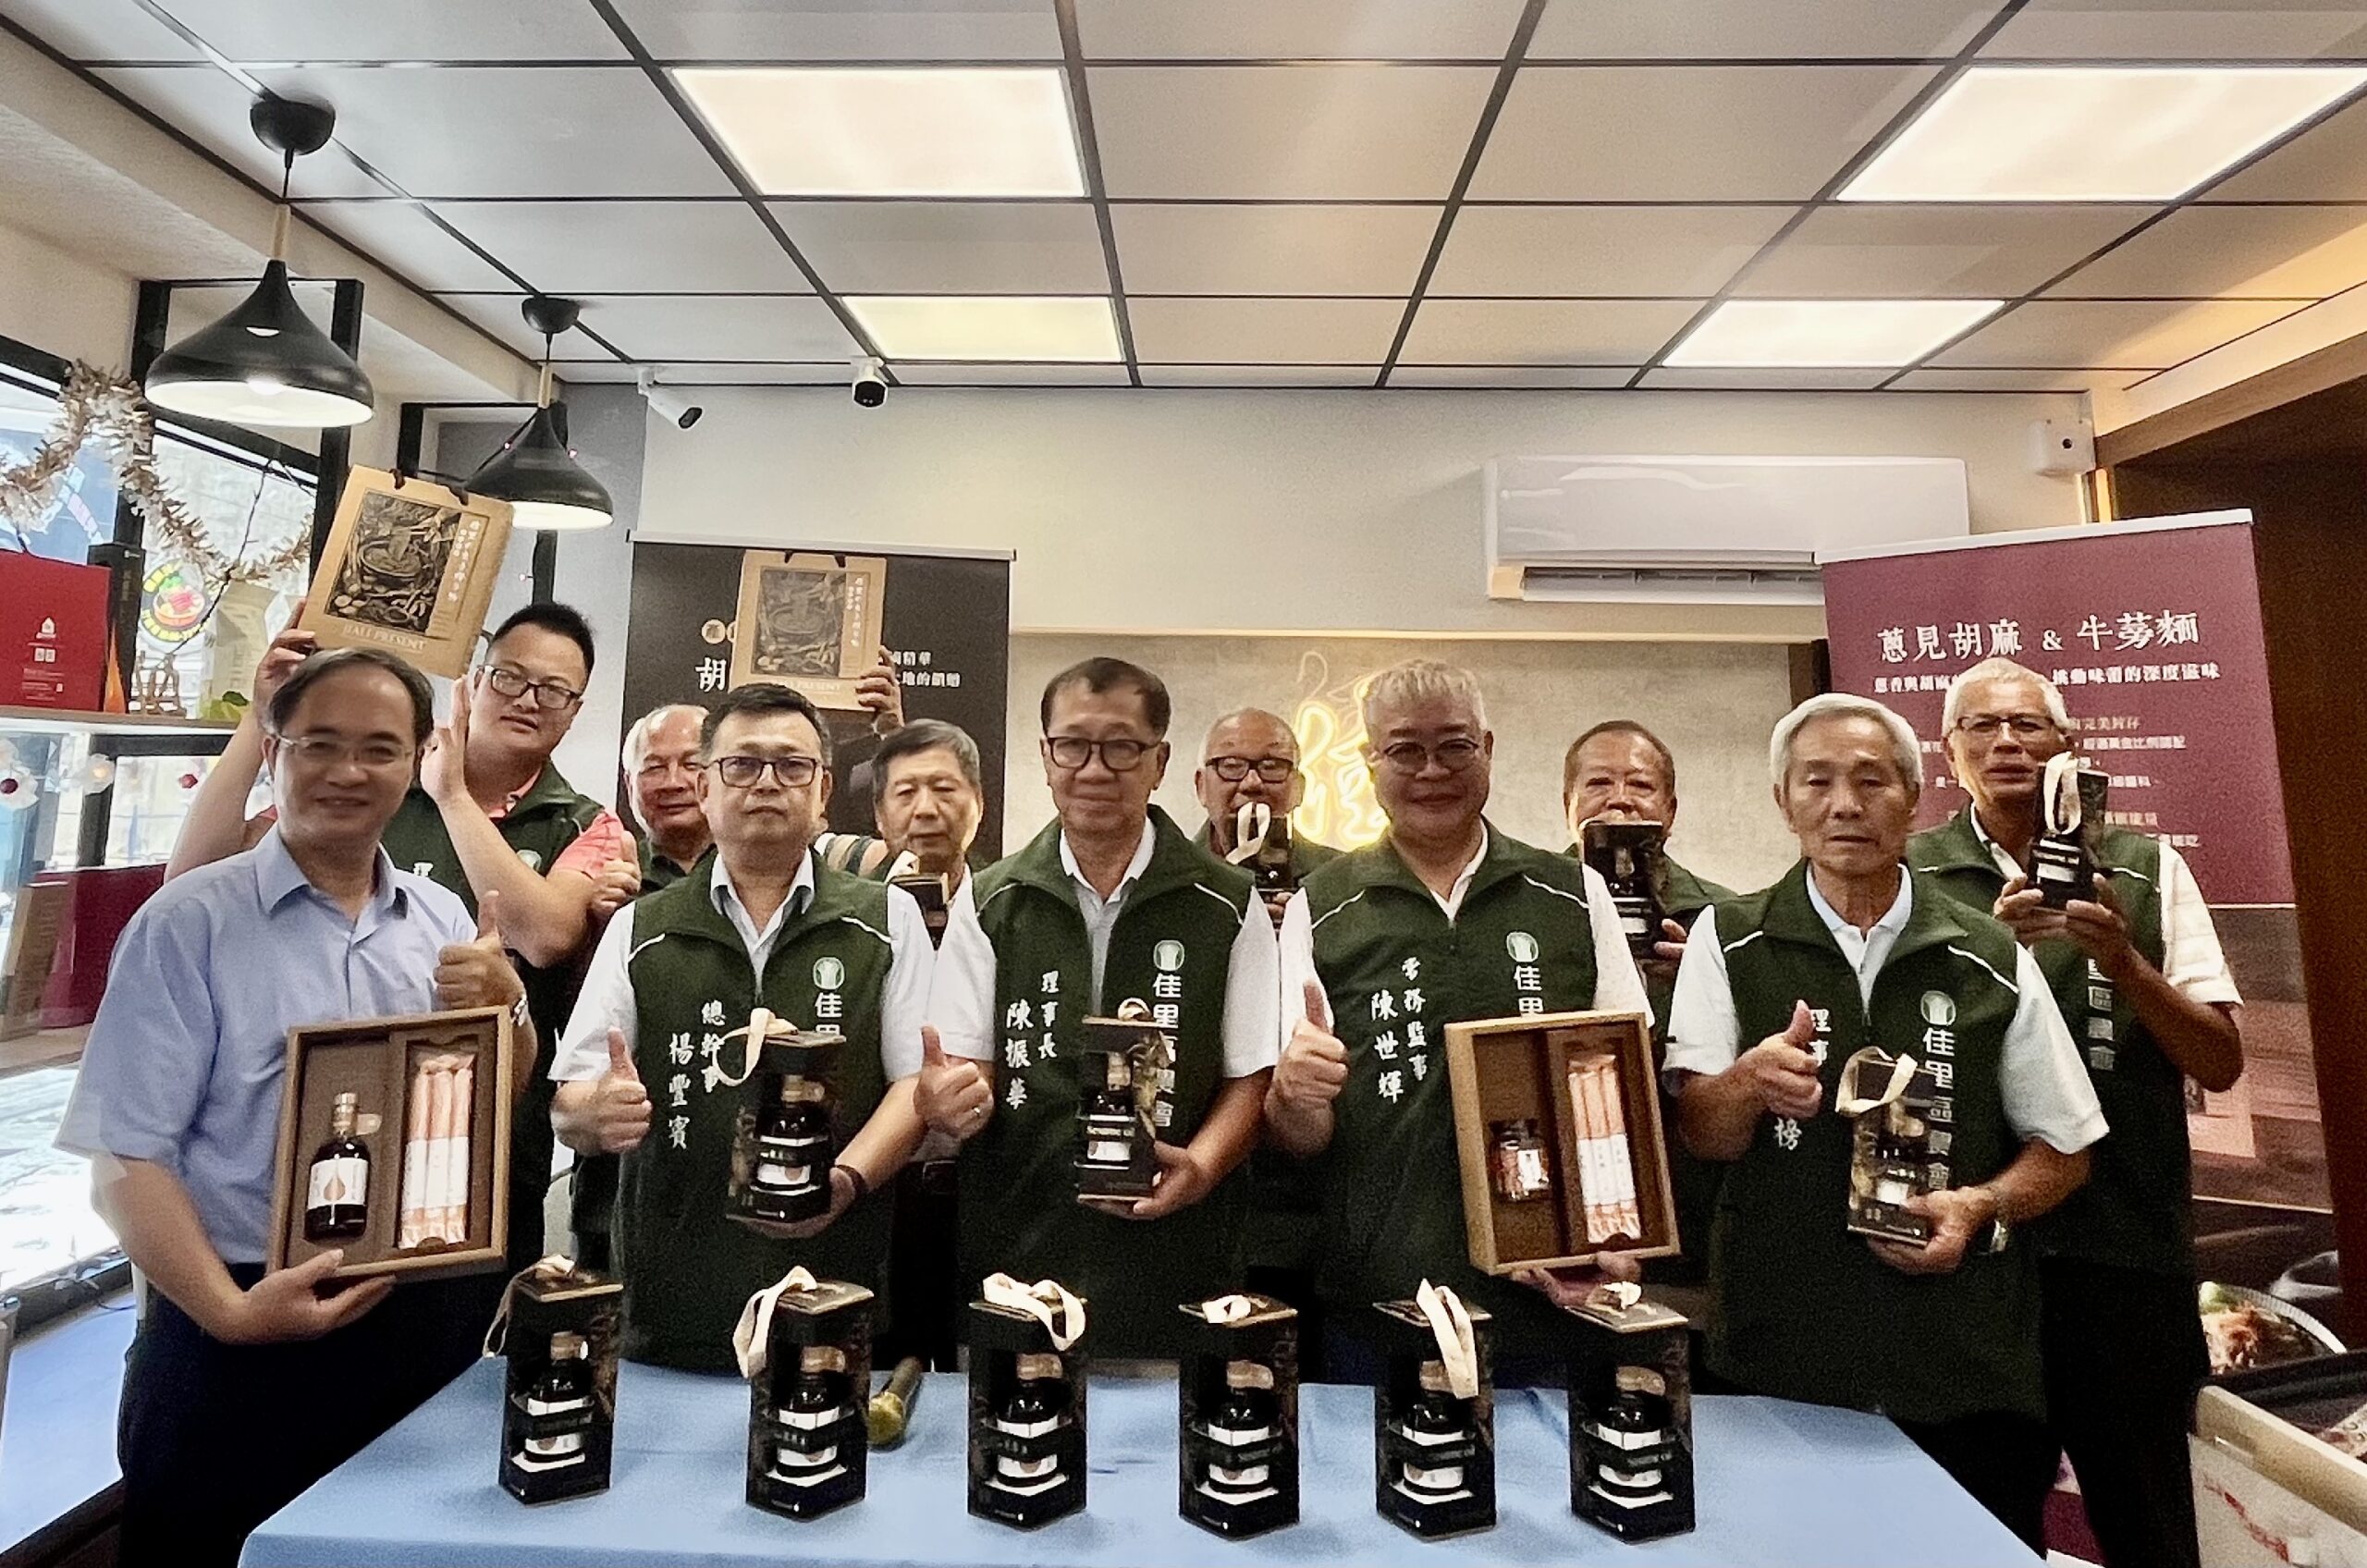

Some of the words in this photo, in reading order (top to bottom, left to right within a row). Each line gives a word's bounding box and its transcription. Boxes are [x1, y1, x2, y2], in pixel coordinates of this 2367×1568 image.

[2042, 630, 2063, 650] &
[2076, 609, 2200, 650] 牛蒡麵
[695, 657, 727, 692] 胡
[1038, 971, 1060, 1059] 理事長
